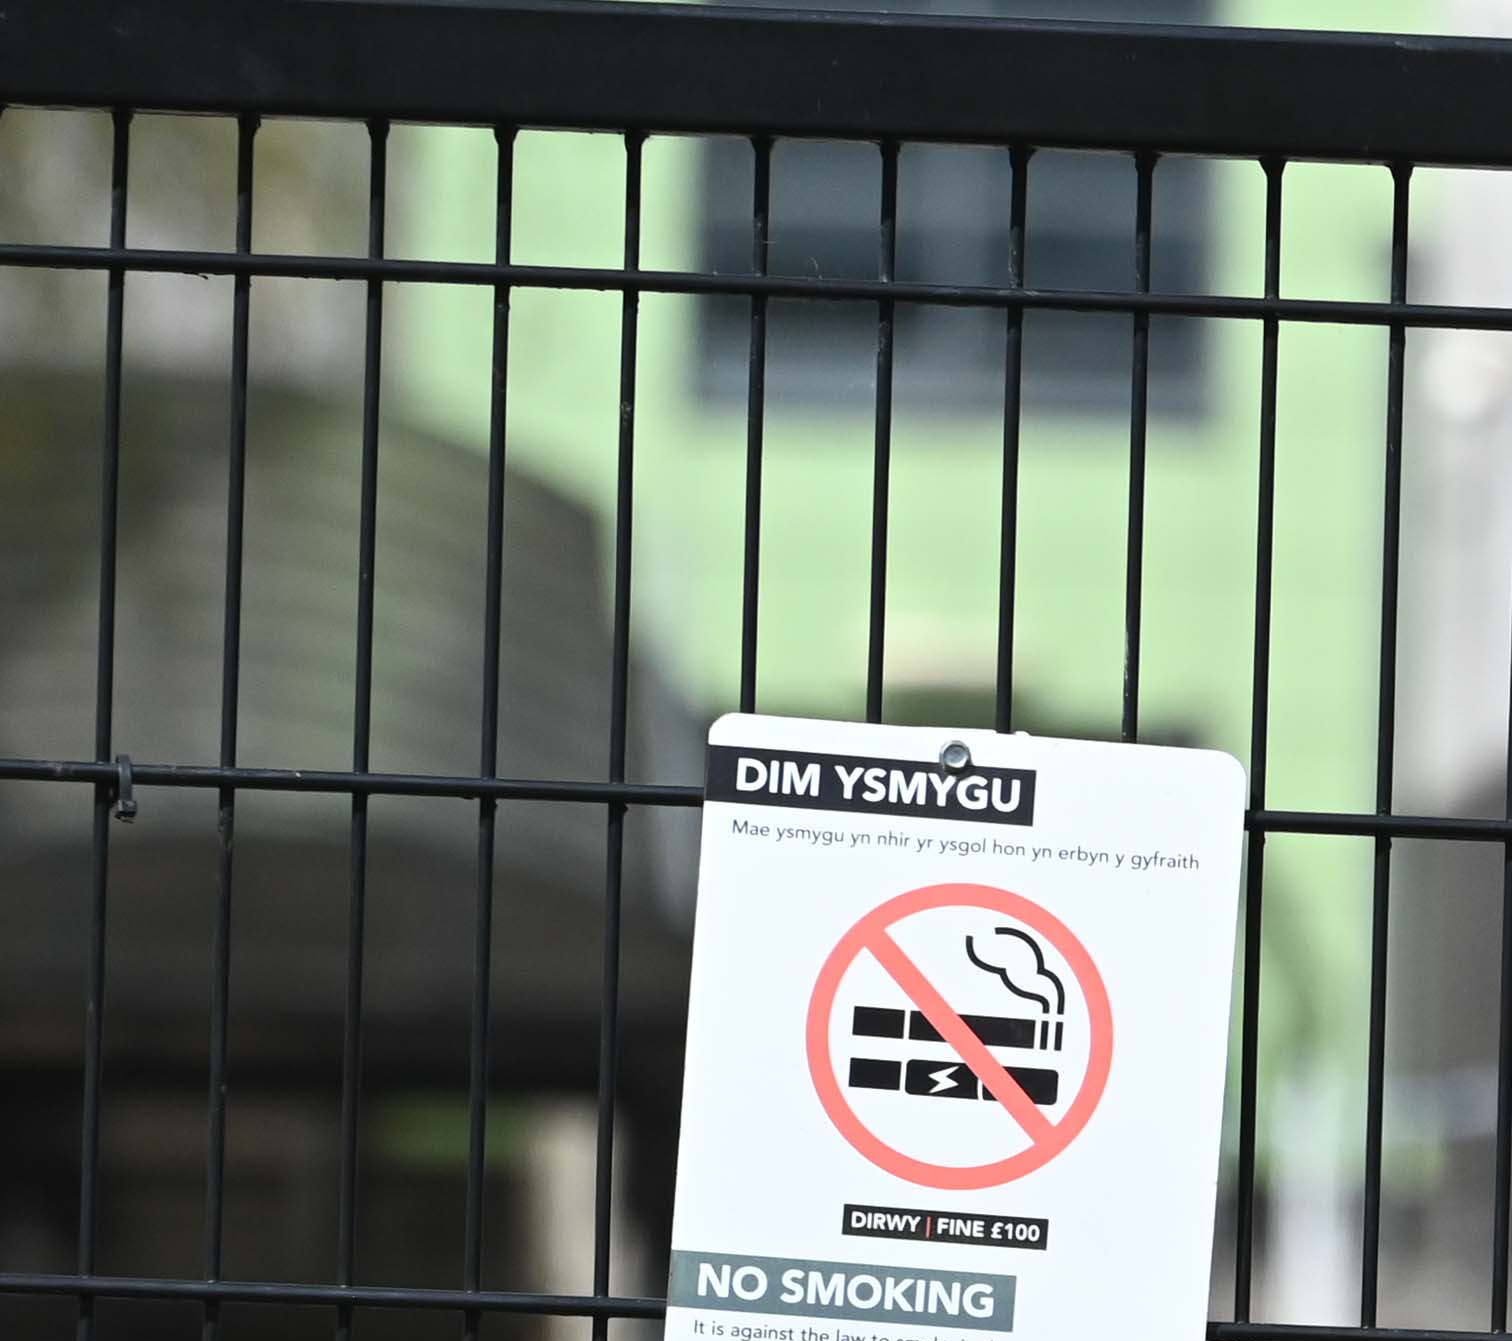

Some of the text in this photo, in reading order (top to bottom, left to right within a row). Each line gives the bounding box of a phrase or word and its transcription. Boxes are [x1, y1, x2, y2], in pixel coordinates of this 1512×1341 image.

[736, 757, 1021, 813] DIM YSMYGU
[732, 819, 1200, 871] Mae ysmygu yn nhir yr ysgol hon yn erbyn y gyfraith
[851, 1211, 1041, 1242] DIRWY FINE £100
[697, 1263, 995, 1318] NO SMOKING
[693, 1319, 705, 1334] It
[712, 1321, 725, 1336] is
[731, 1324, 794, 1341] against
